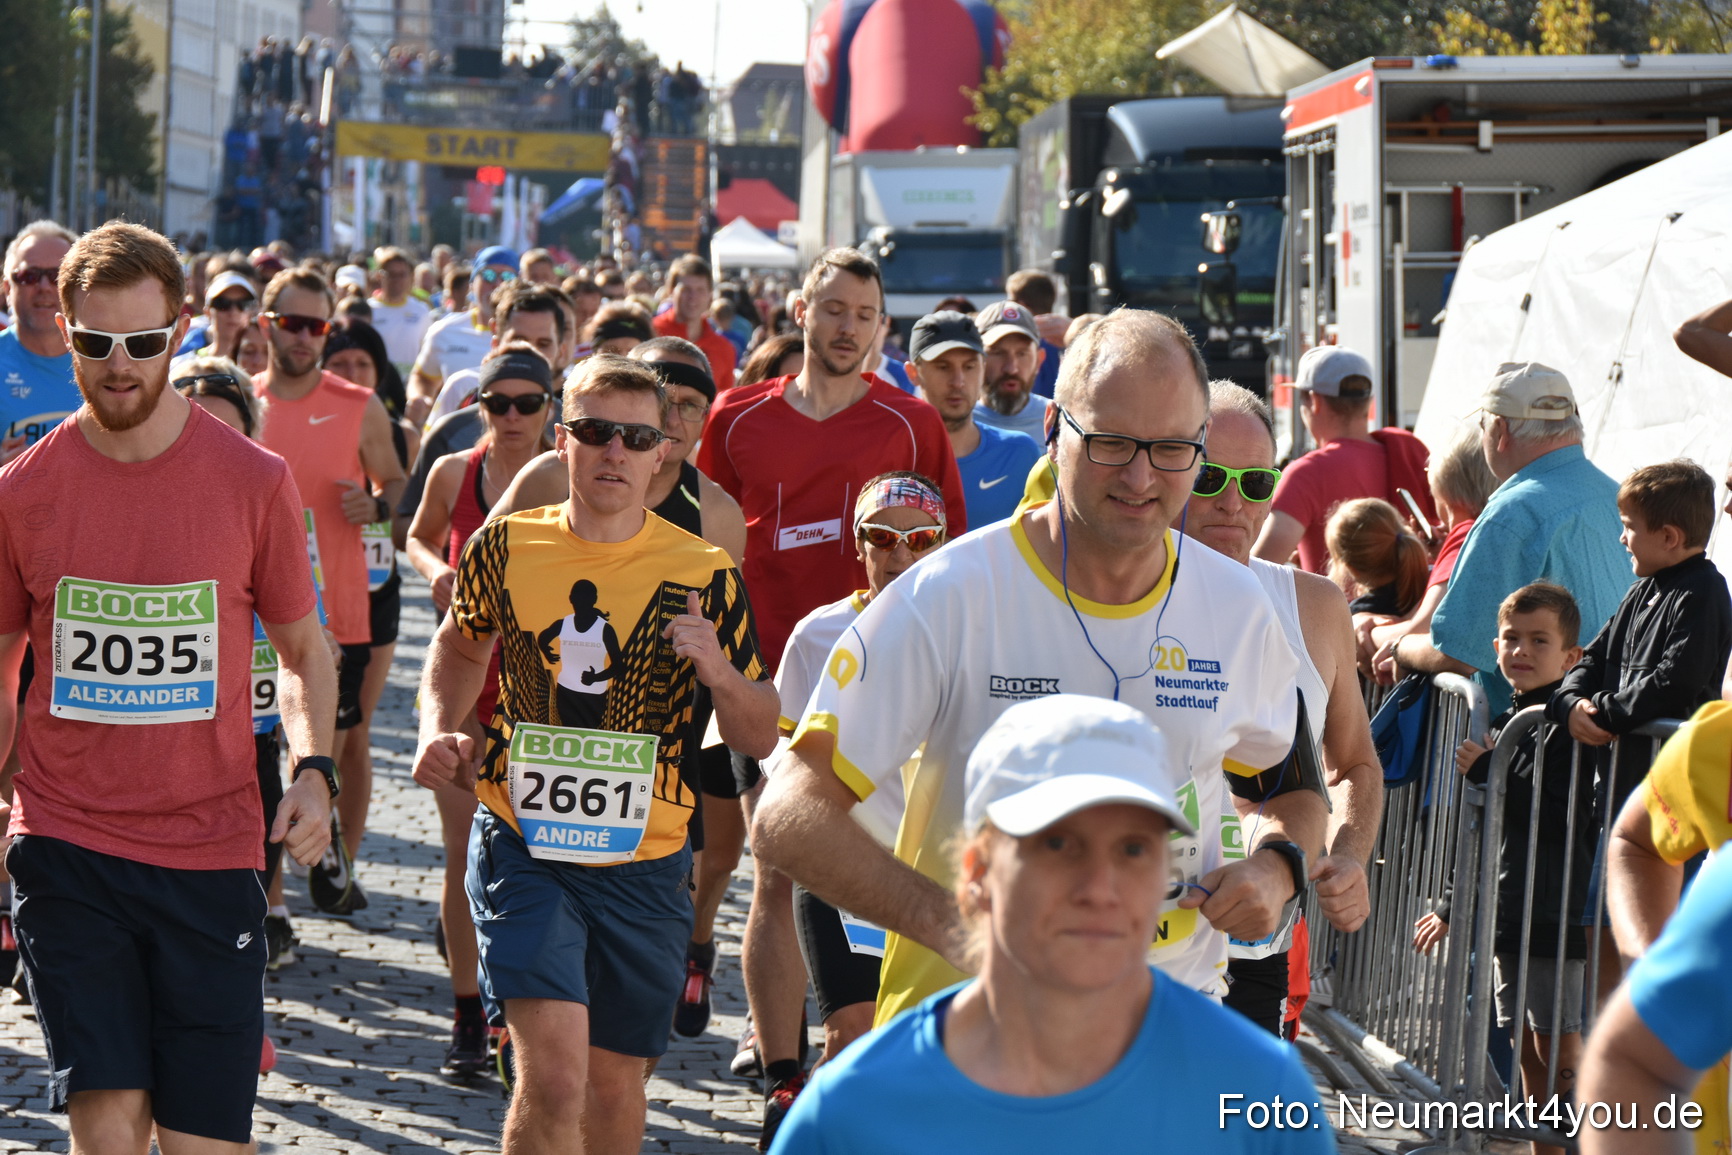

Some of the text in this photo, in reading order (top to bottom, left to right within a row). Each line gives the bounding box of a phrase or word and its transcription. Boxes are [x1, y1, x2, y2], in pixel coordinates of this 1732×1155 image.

[424, 132, 519, 160] START
[796, 528, 824, 541] DEHN
[68, 585, 204, 621] BOCK
[203, 635, 211, 643] C
[563, 640, 602, 648] FERRERO
[71, 630, 198, 676] 2035
[1154, 646, 1218, 671] 20 JAHRE
[990, 674, 1061, 694] BOCK
[1154, 675, 1229, 692] Neumarkter
[68, 685, 200, 705] ALEXANDER
[1155, 694, 1219, 712] Stadtlauf
[519, 730, 645, 769] BOCK
[520, 771, 632, 819] 2661
[640, 785, 646, 793] D
[533, 826, 611, 849] ANDRÉ
